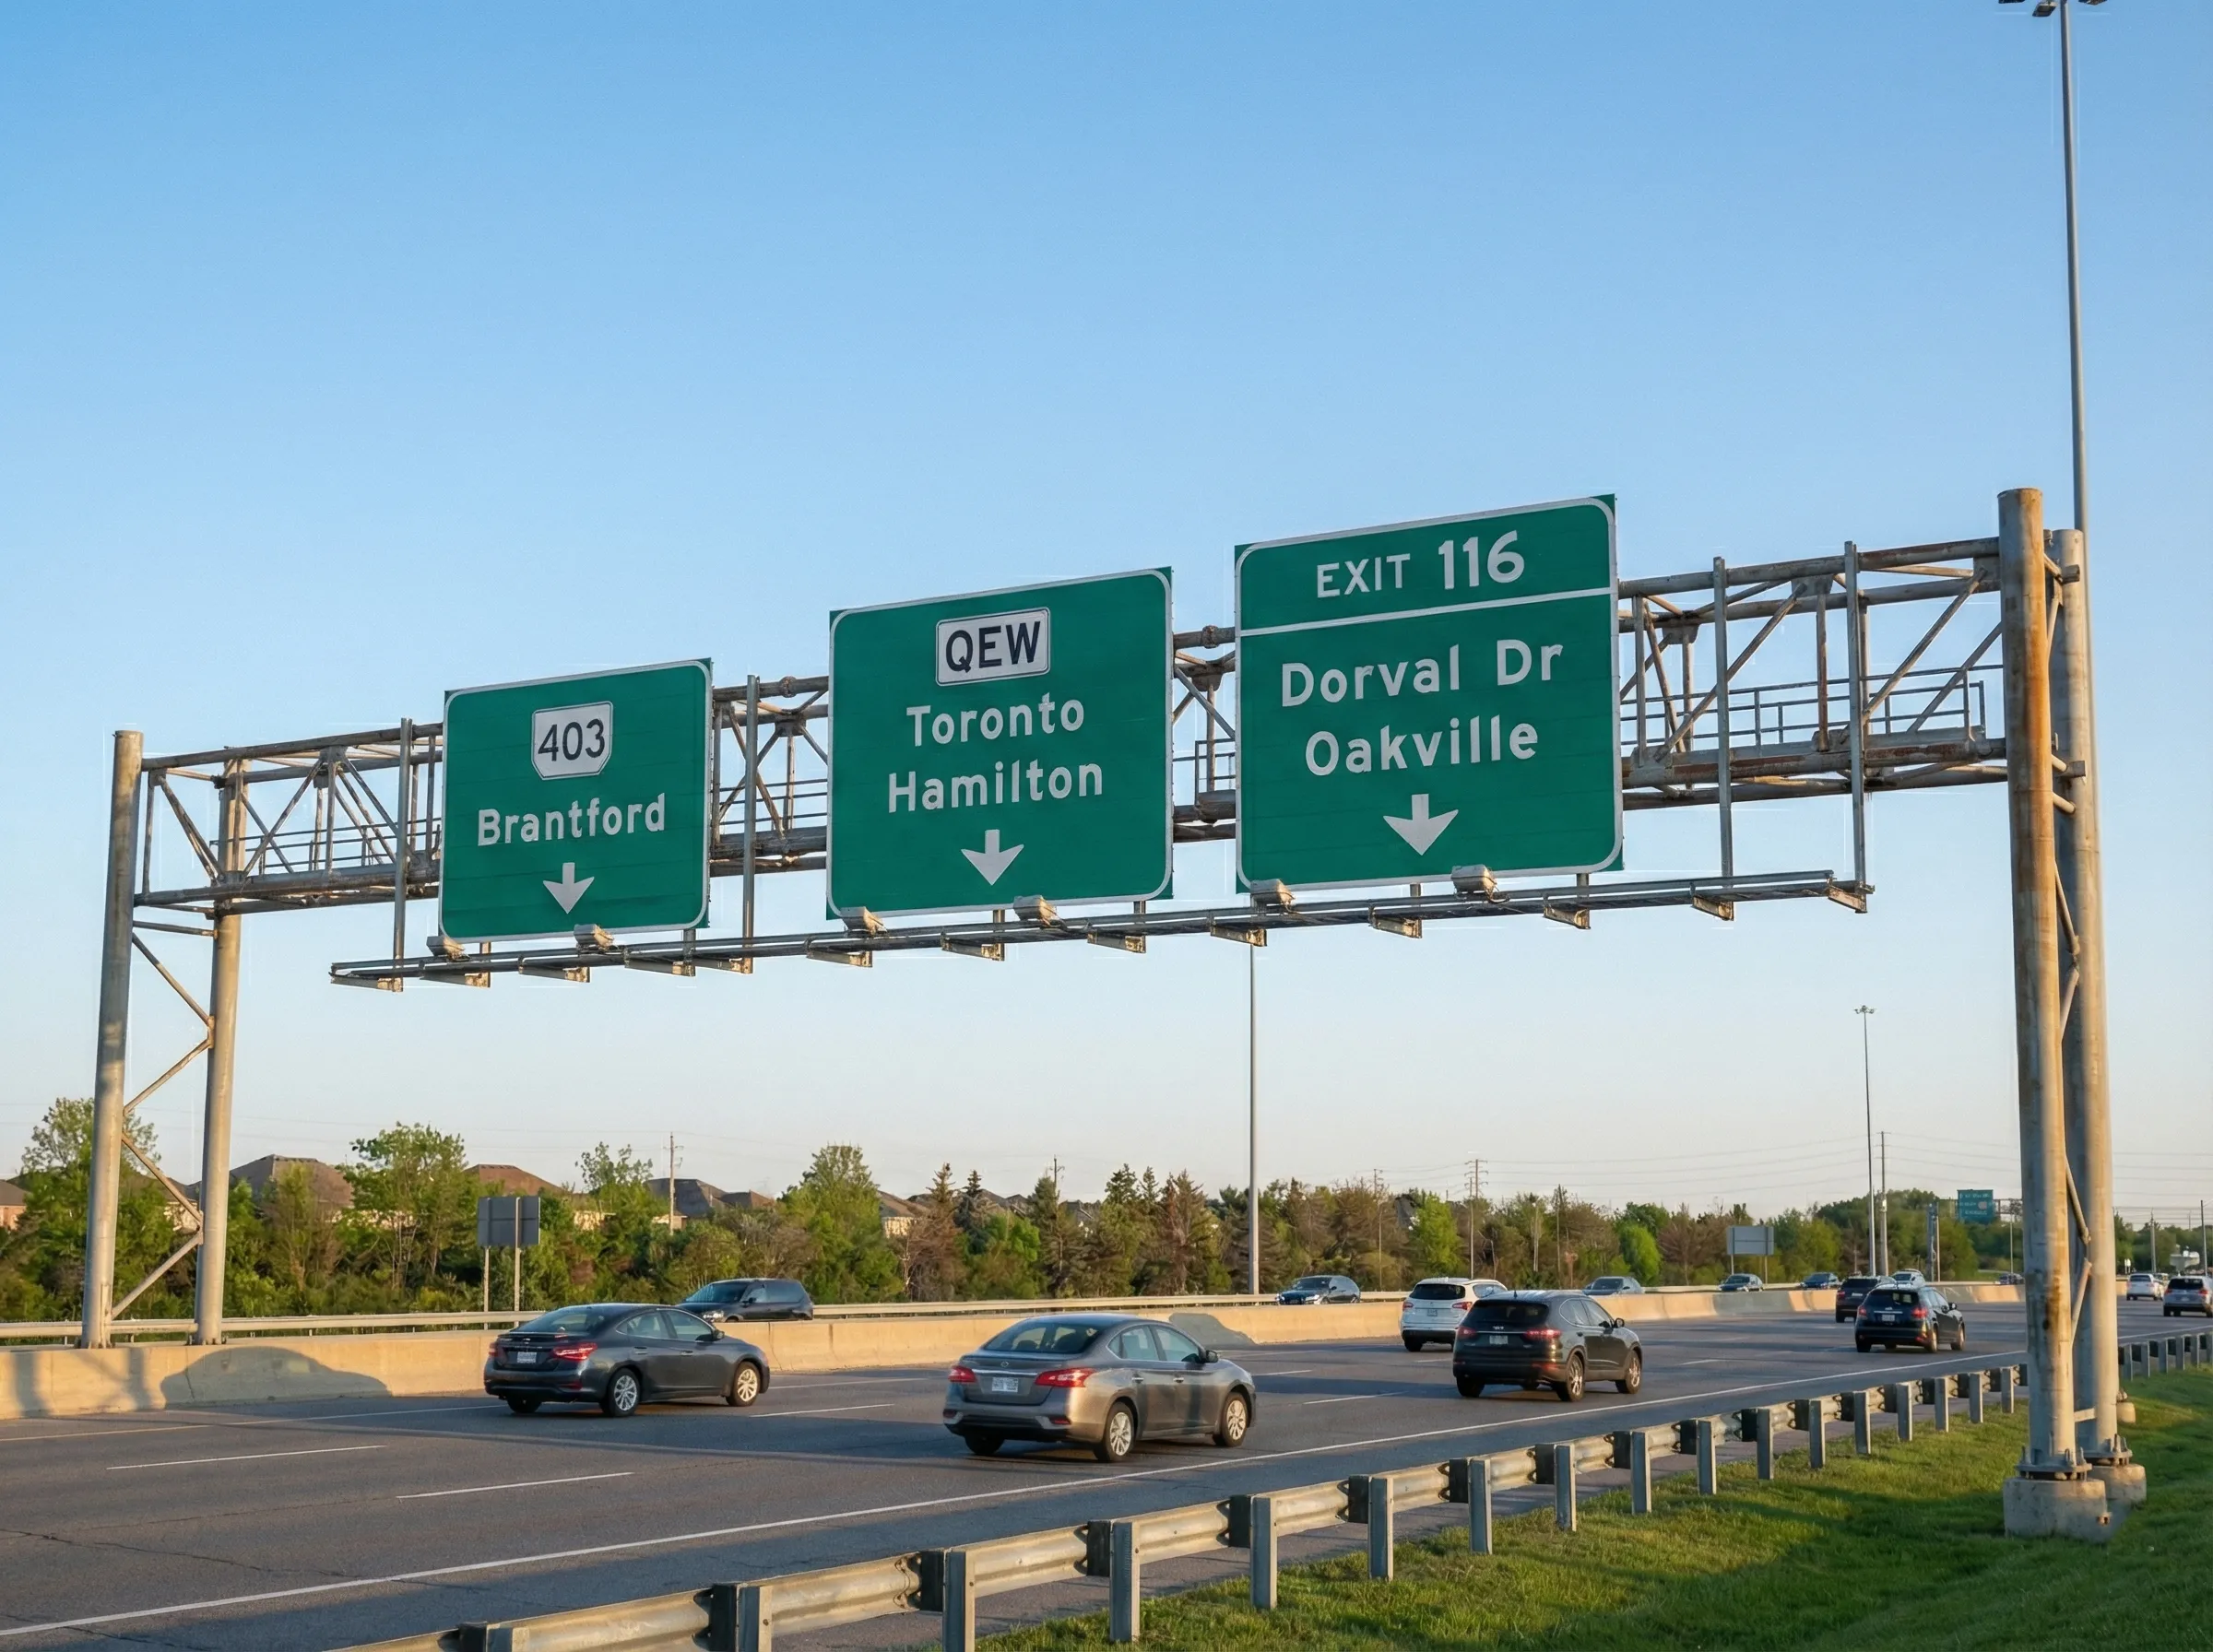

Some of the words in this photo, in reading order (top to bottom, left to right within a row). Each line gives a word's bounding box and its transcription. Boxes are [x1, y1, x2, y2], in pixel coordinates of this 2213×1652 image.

[1317, 553, 1411, 598] EXIT
[1438, 530, 1525, 590] 116
[945, 620, 1041, 673] QEW
[1282, 644, 1460, 707] Dorval
[1497, 639, 1564, 686] Dr
[538, 718, 606, 761] 403
[906, 692, 1084, 747] Toronto
[1305, 714, 1538, 776] Oakville
[889, 759, 1103, 813] Hamilton
[478, 792, 665, 846] Brantford
